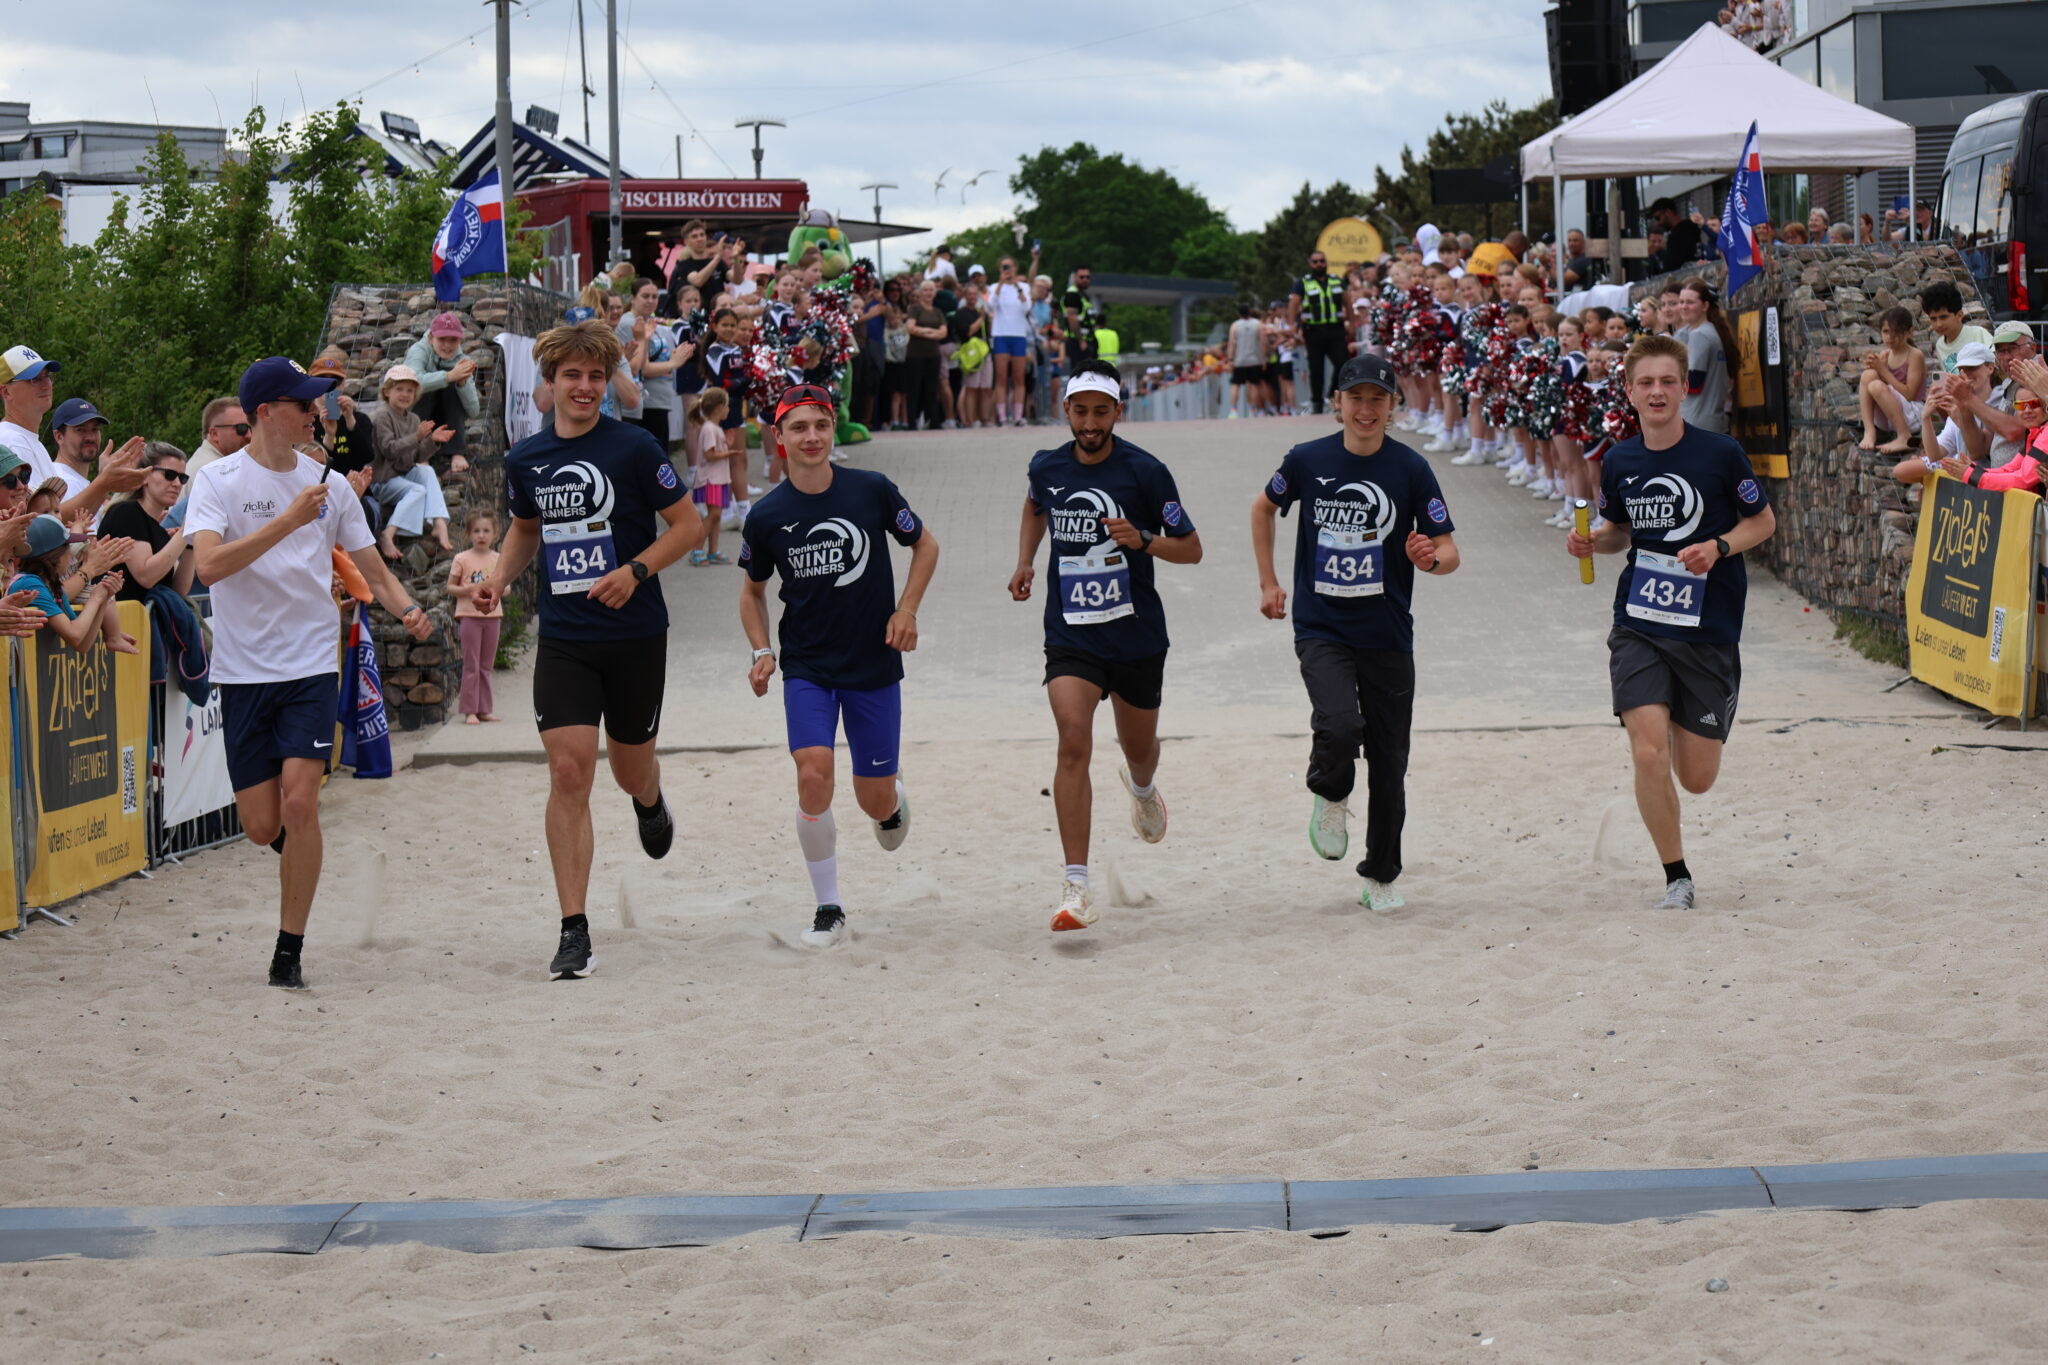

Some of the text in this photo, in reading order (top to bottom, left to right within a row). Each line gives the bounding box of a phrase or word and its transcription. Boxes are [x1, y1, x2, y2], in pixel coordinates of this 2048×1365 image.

[535, 482, 587, 496] DenkerWulf
[535, 491, 584, 510] WIND
[1315, 498, 1372, 511] DenkerWulf
[1625, 494, 1677, 506] DenkerWulf
[1314, 506, 1368, 525] WIND
[1626, 503, 1674, 520] WIND
[1631, 518, 1676, 529] UNNERS
[788, 538, 845, 556] DenkerWulf
[555, 545, 607, 575] 434
[788, 547, 843, 570] WIND
[1324, 554, 1374, 581] 434
[794, 562, 845, 579] RUNNERS
[1070, 578, 1122, 607] 434
[1639, 577, 1693, 609] 434
